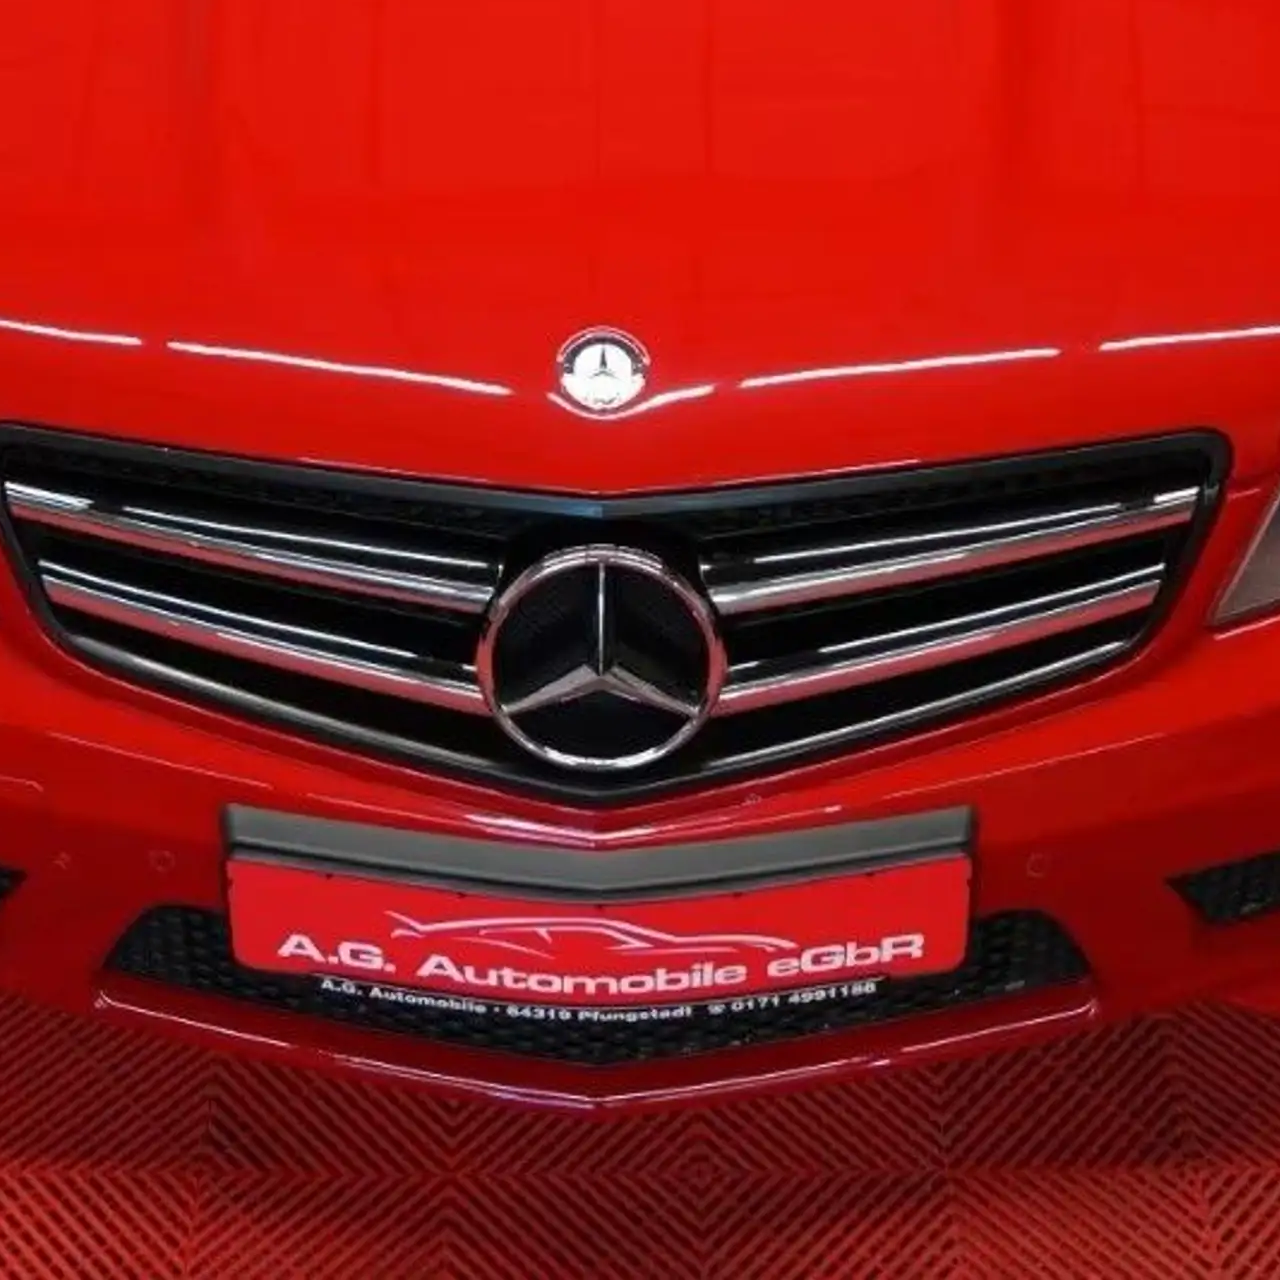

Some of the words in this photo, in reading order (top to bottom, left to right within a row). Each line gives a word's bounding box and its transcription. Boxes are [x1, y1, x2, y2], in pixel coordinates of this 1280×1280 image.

[278, 934, 396, 973] A.G.
[416, 953, 748, 996] Automobile
[767, 933, 925, 977] eGbR
[321, 978, 363, 996] A.G.
[369, 986, 487, 1014] Automobile
[578, 1006, 693, 1023] Pfungstadt
[731, 994, 780, 1013] 0171
